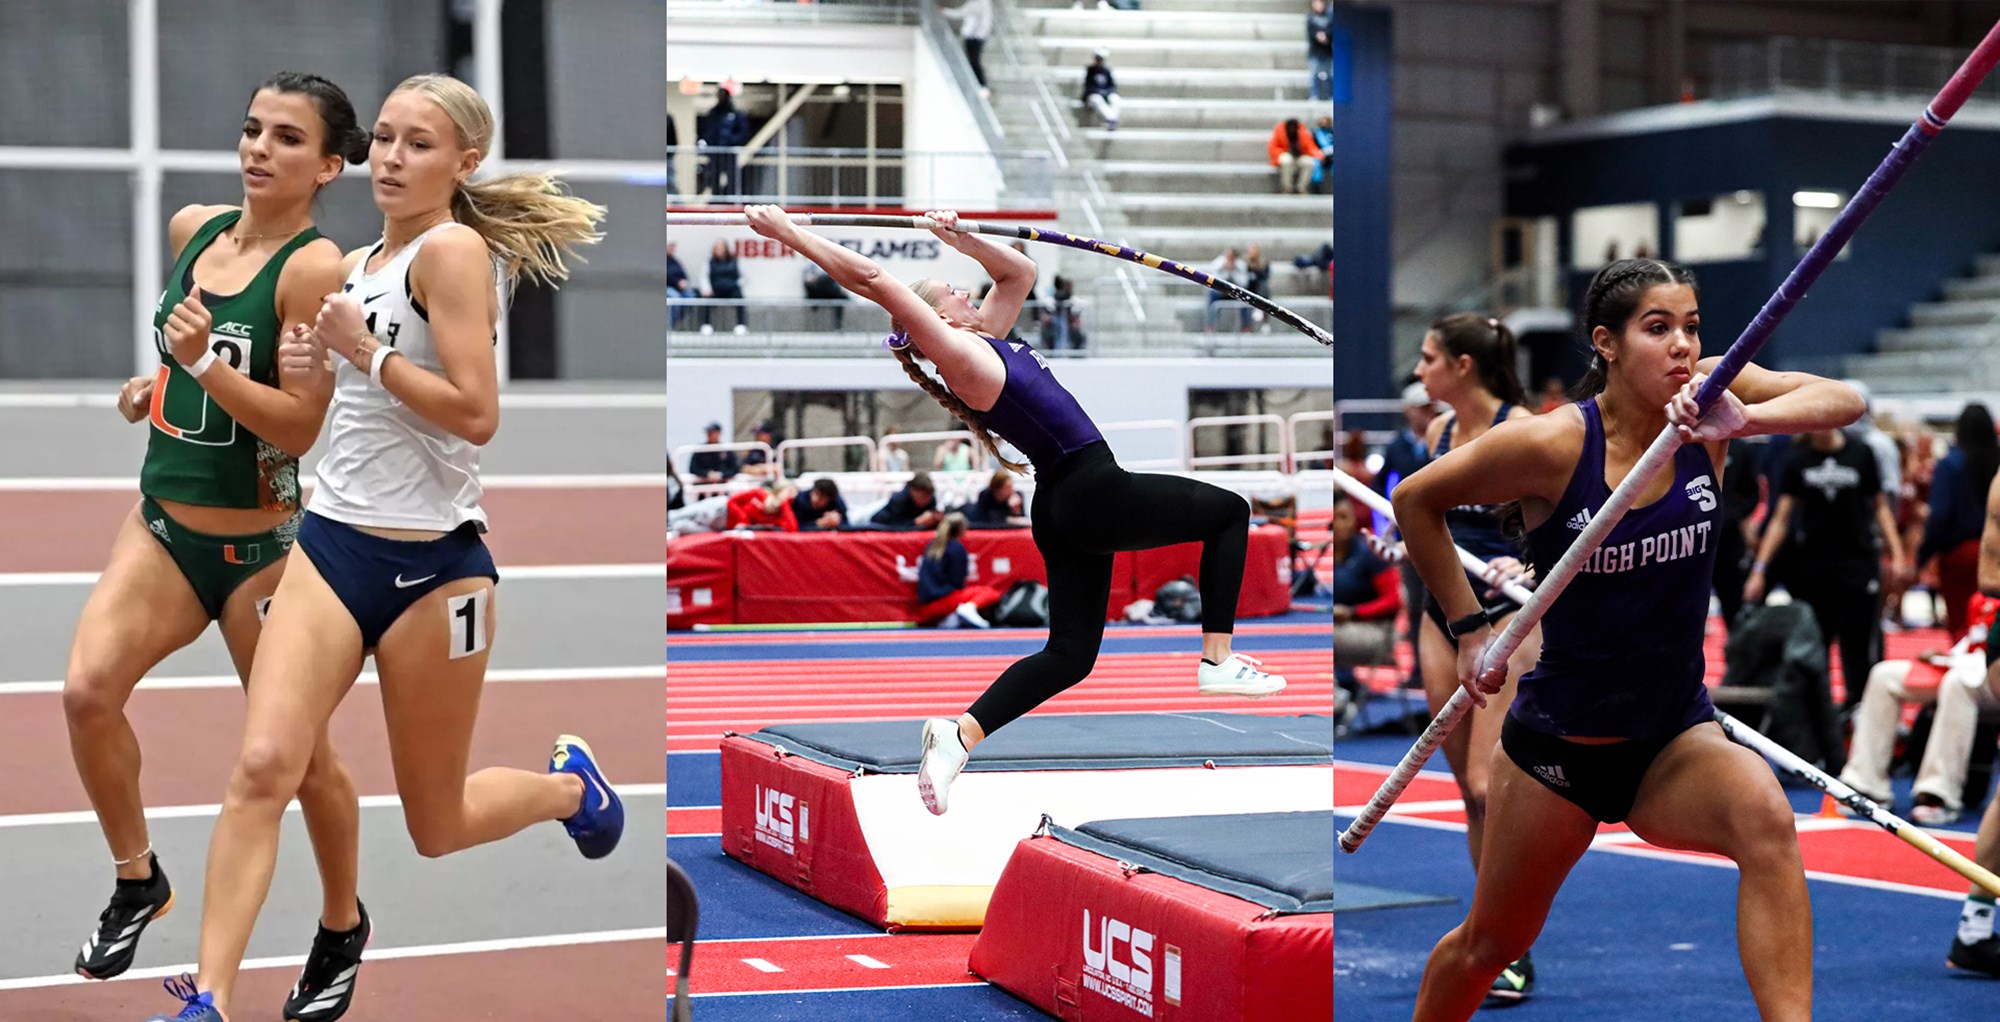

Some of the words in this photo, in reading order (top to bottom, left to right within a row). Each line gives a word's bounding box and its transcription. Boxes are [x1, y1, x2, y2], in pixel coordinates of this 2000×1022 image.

[217, 321, 253, 336] ACC
[224, 543, 260, 564] U
[1640, 520, 1711, 566] POINT
[456, 597, 475, 652] 1
[1533, 766, 1570, 787] adidas
[756, 784, 793, 838] UCS
[1083, 908, 1153, 993] UCS
